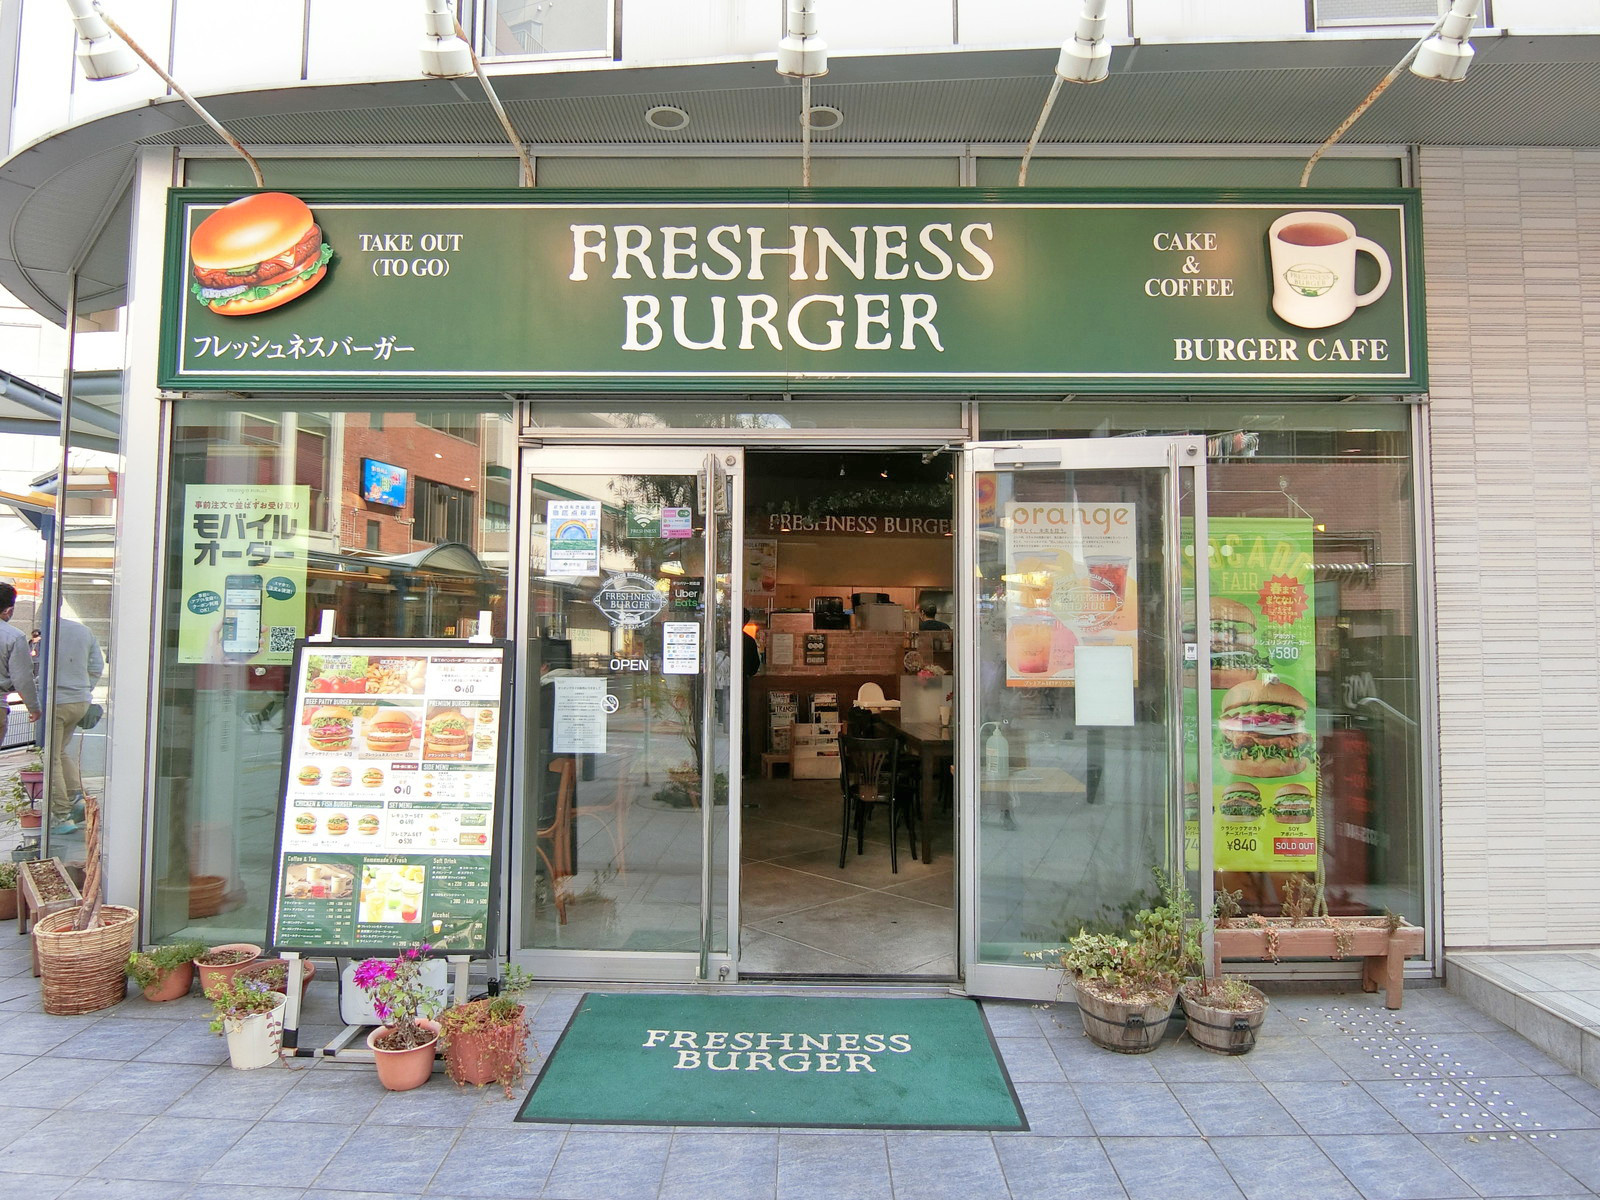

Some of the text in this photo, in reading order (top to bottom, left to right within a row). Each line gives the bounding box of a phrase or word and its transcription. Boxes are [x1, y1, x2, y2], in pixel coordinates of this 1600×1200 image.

[359, 233, 463, 252] TAKE OUT
[1153, 232, 1218, 251] CAKE
[569, 222, 995, 283] FRESHNESS
[372, 257, 450, 278] (TO GO)
[1182, 254, 1201, 275] &
[1144, 278, 1234, 298] COFFEE
[621, 293, 945, 353] BURGER
[193, 333, 416, 361] フレッシュネスバーガー
[1174, 338, 1389, 362] BURGER CAFE
[194, 513, 297, 539] モバイル
[769, 513, 953, 534] FRESHNESS BURGE
[1012, 507, 1129, 535] orange
[194, 541, 294, 566] オーダー
[1222, 571, 1258, 590] FAIR
[1270, 582, 1298, 595] 春まで
[605, 592, 656, 601] FRESHNESS
[675, 589, 698, 598] Uber
[675, 599, 698, 607] Eats
[610, 600, 650, 609] BURGER
[1268, 647, 1299, 659] ¥580
[610, 659, 649, 671] OPEN
[1227, 838, 1257, 851] ¥840
[1275, 842, 1314, 850] SOLD OUT
[642, 1029, 912, 1053] FRESHNESS
[673, 1050, 877, 1073] BURGER
